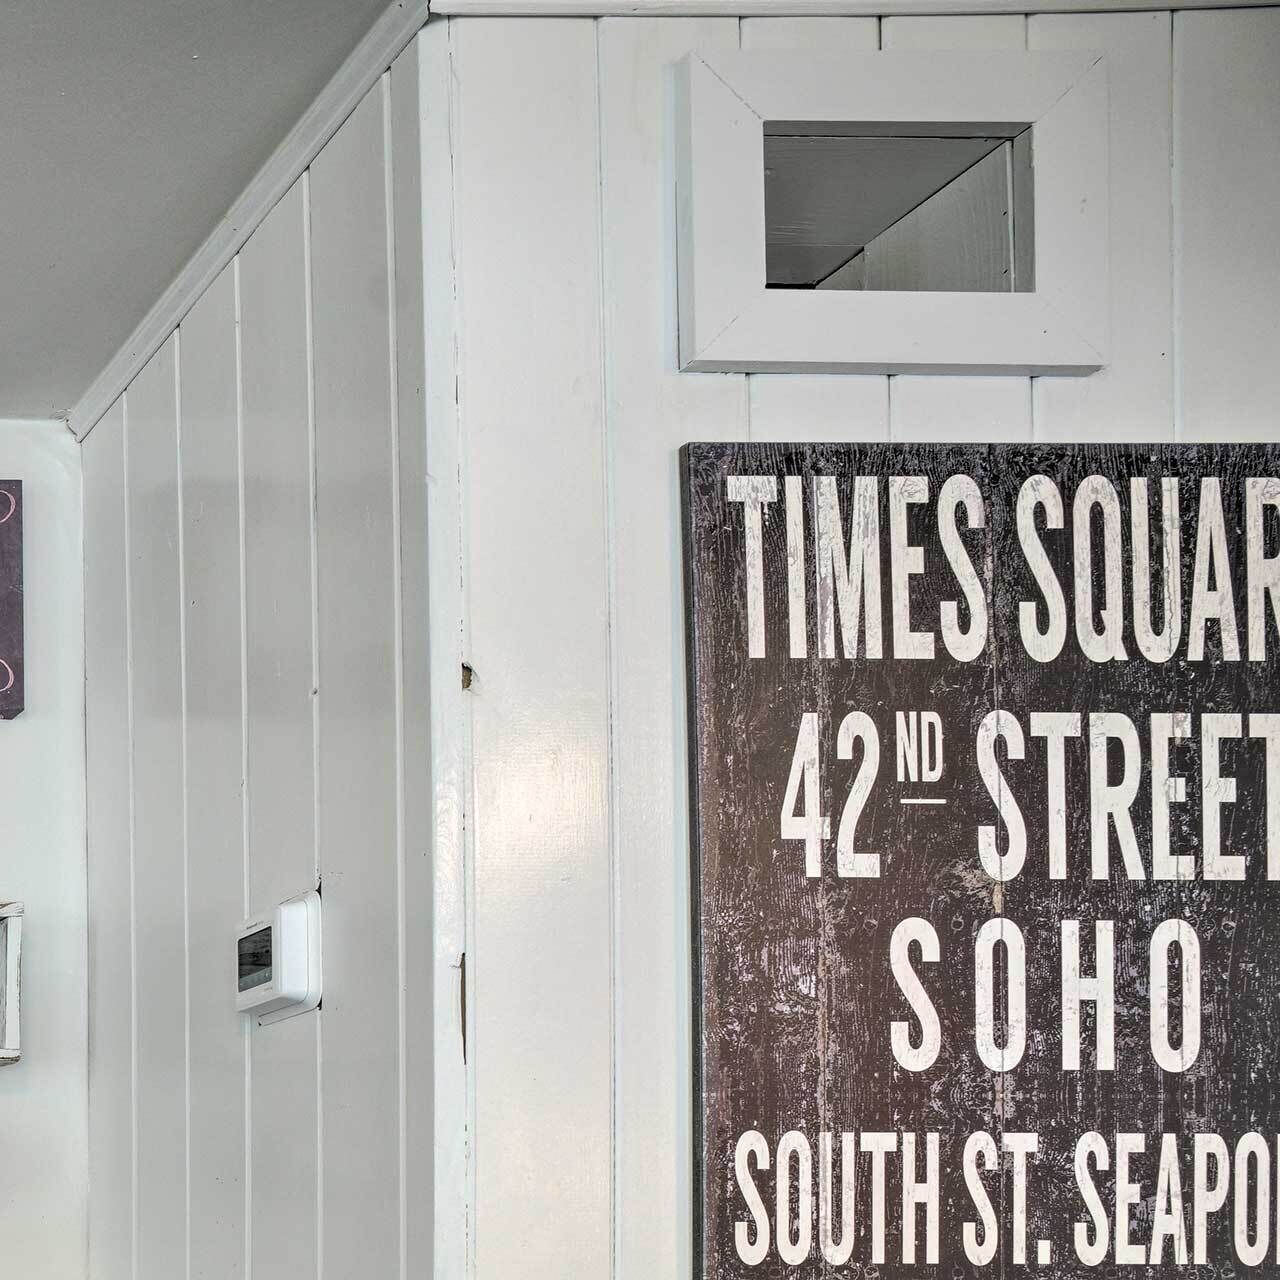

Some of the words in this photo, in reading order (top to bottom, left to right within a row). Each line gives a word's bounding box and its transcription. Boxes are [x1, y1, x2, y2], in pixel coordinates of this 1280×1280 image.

[727, 474, 988, 663] TIMES
[1016, 474, 1280, 664] SQUAR
[976, 710, 1280, 882] STREET
[889, 917, 1202, 1073] SOHO
[734, 1130, 940, 1266] SOUTH
[963, 1131, 1051, 1266] ST.
[1073, 1131, 1280, 1266] SEAPO
